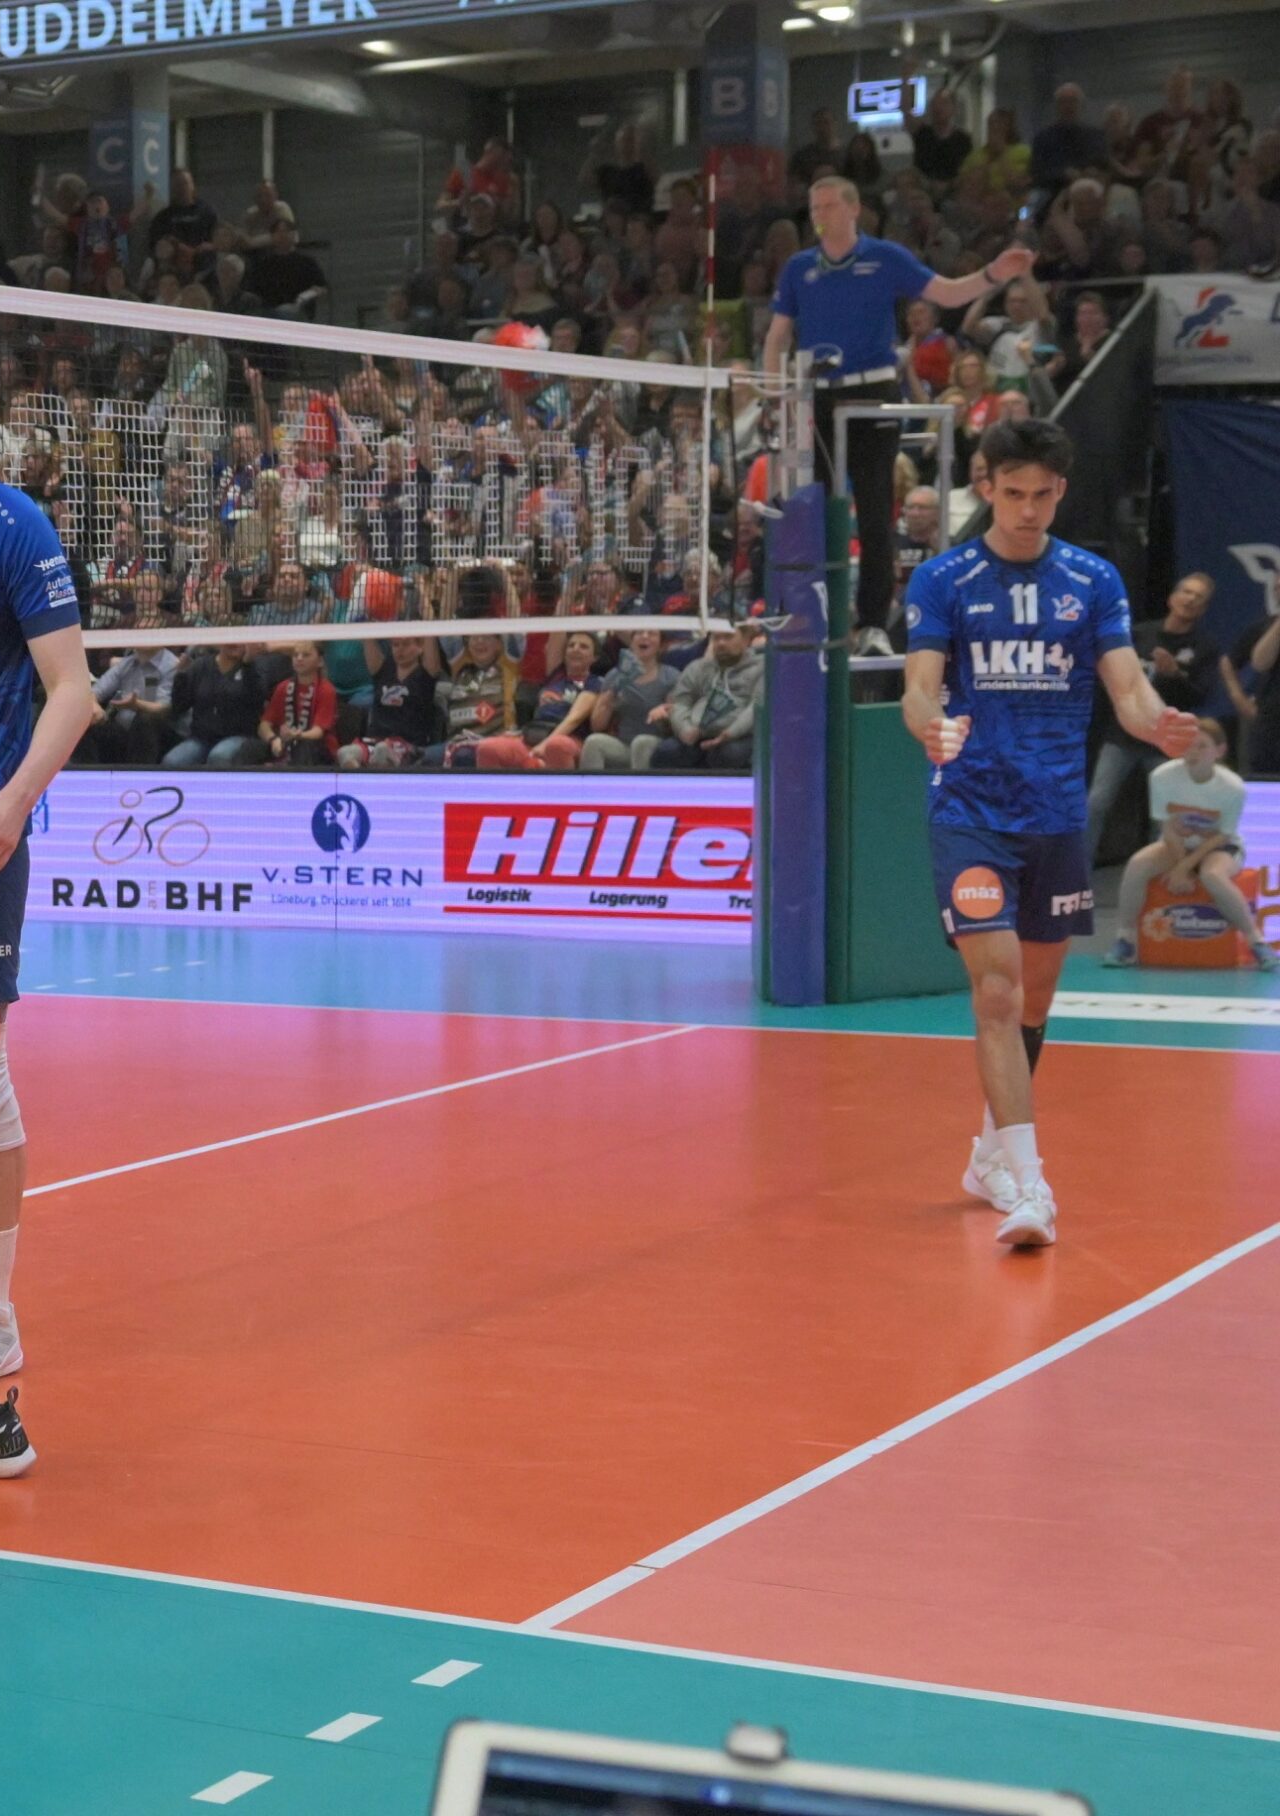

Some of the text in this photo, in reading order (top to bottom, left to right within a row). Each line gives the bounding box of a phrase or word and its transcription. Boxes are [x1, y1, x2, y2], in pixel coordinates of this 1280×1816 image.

[143, 138, 160, 174] C
[1009, 583, 1038, 625] 11
[969, 640, 1045, 674] LKH
[466, 811, 753, 881] Hille
[52, 878, 141, 909] RAD
[166, 881, 253, 912] BHF
[467, 887, 532, 905] Logistik
[589, 891, 669, 909] Lagerung
[957, 887, 1001, 900] maz
